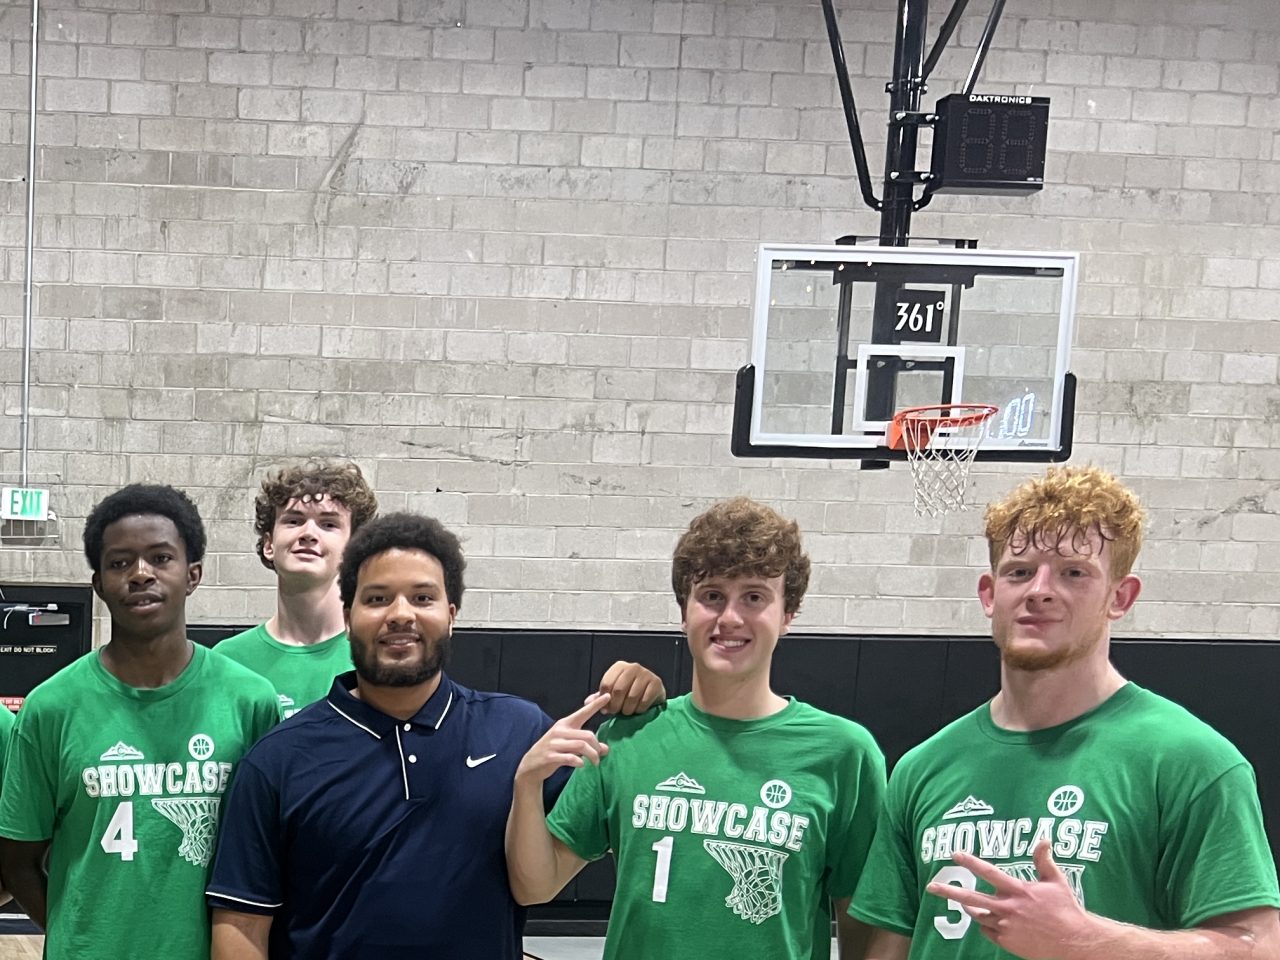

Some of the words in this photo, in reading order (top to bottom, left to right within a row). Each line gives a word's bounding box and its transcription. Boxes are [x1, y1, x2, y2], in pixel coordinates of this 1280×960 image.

[969, 95, 1032, 104] DAKTRONICS
[11, 490, 42, 515] EXIT
[82, 761, 233, 798] SHOWCASE
[100, 801, 139, 861] 4
[632, 794, 810, 852] SHOWCASE
[920, 817, 1109, 864] SHOWCASE
[651, 836, 674, 903] 1
[932, 866, 977, 940] 3
